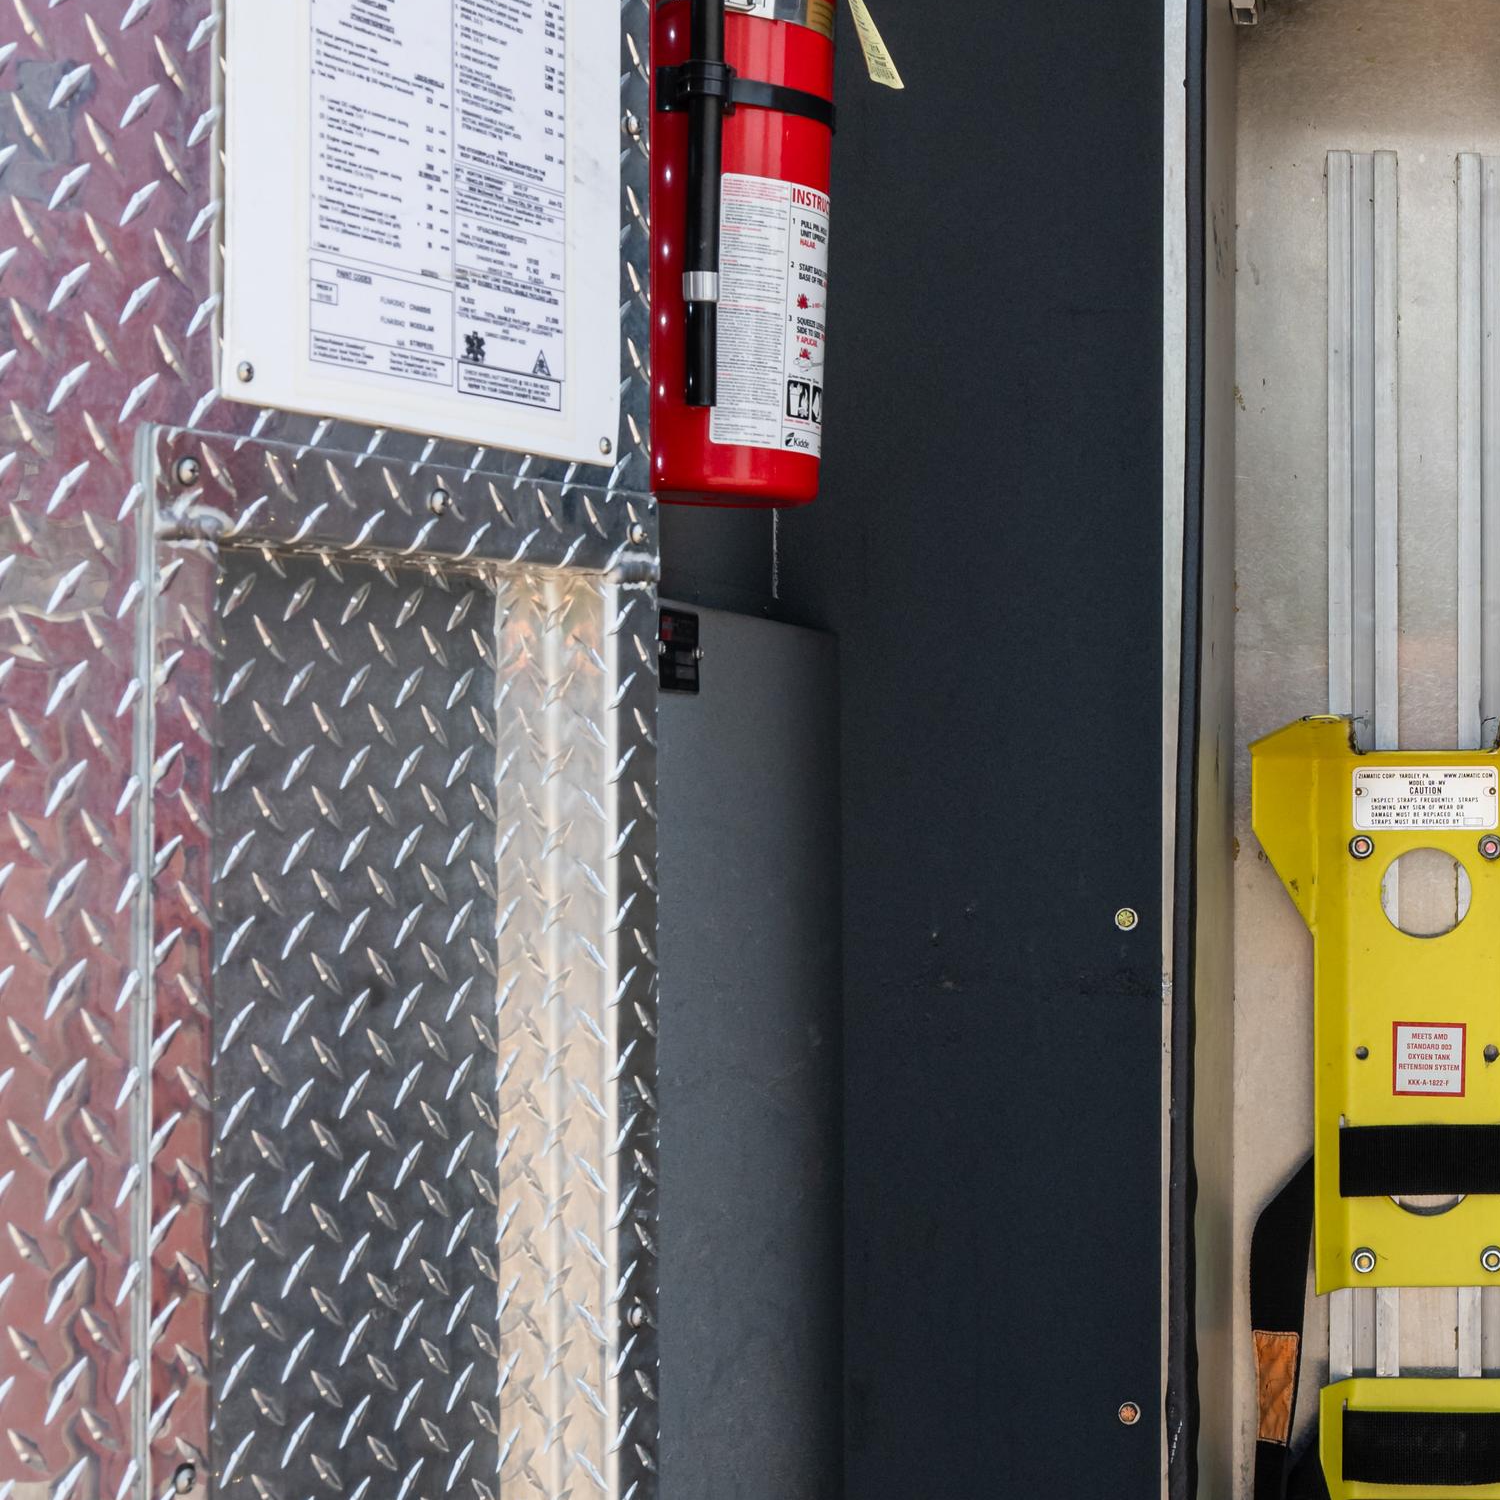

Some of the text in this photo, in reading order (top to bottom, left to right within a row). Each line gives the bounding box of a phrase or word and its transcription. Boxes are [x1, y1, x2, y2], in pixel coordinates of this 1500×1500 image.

[800, 220, 812, 229] PULL
[800, 229, 812, 238] UNIT
[799, 263, 813, 273] START
[798, 273, 811, 283] BASE
[797, 316, 816, 328] SQUEEZE
[796, 325, 808, 335] SIDE
[793, 437, 810, 449] Kidde
[1409, 786, 1442, 795] CAUTION
[1411, 1032, 1433, 1040] MEETS
[1407, 1042, 1440, 1050] STANDARD
[1434, 1053, 1451, 1061] TANK
